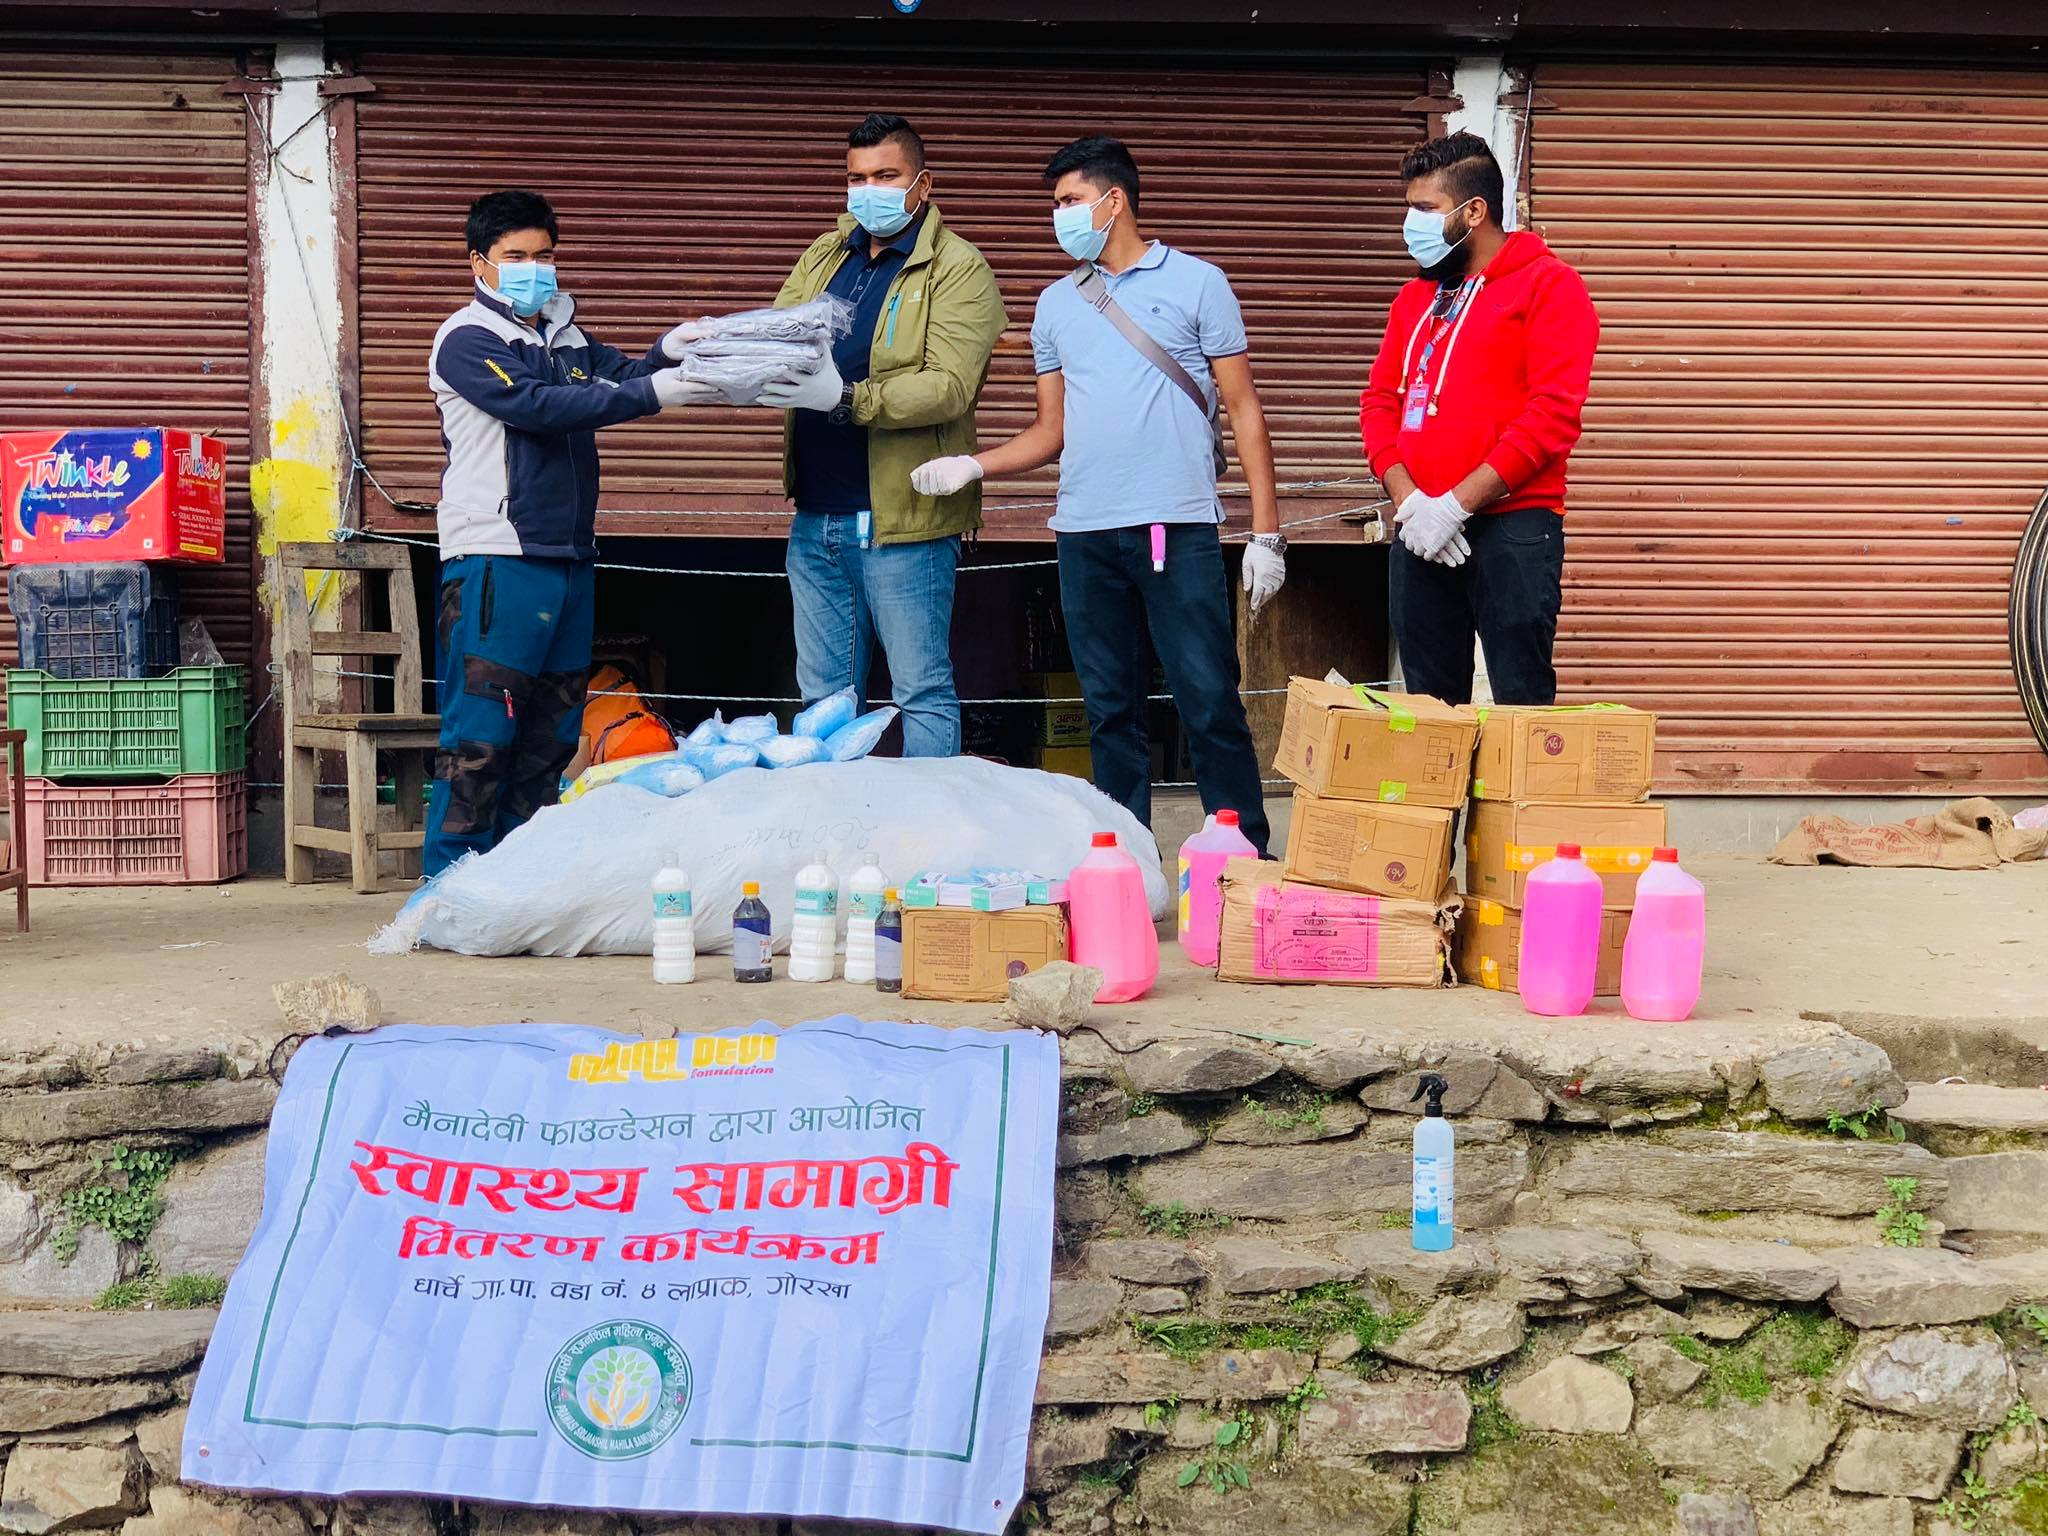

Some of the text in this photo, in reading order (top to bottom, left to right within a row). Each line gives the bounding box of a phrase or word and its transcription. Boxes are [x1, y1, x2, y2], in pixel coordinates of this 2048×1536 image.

[403, 1095, 925, 1146] मैनादेवी फाउन्डेसन द्वारा आयोजित
[349, 1139, 961, 1215] स्वास्थ्य सामाग्री
[398, 1215, 885, 1265] वितरण कार्यक्रम
[550, 1280, 593, 1301] वडा
[766, 1271, 852, 1300] गोरखा
